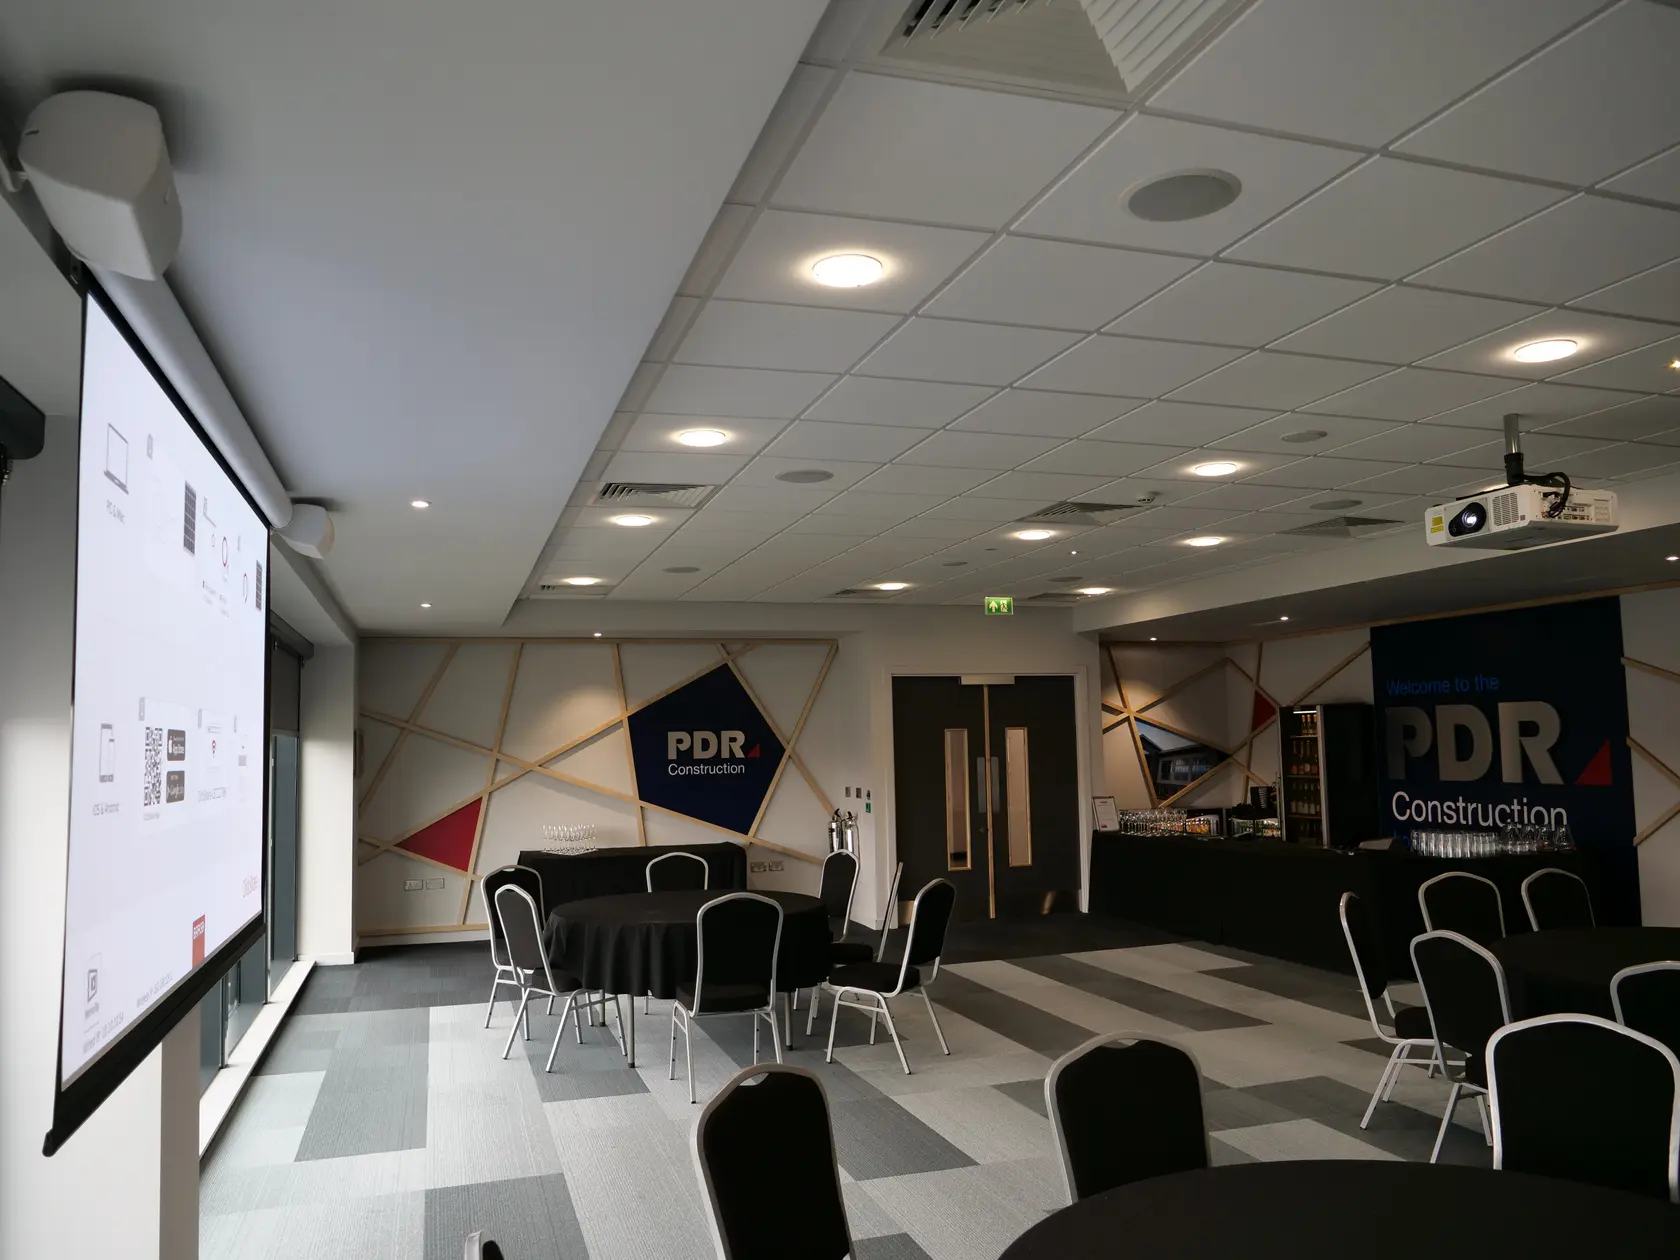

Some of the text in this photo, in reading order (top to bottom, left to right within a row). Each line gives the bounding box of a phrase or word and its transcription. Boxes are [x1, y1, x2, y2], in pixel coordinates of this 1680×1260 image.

[1386, 674, 1500, 696] Welcome to the
[667, 730, 746, 760] PDR
[1385, 700, 1565, 785] PDR
[668, 762, 745, 776] Construction
[1391, 790, 1568, 831] Construction
